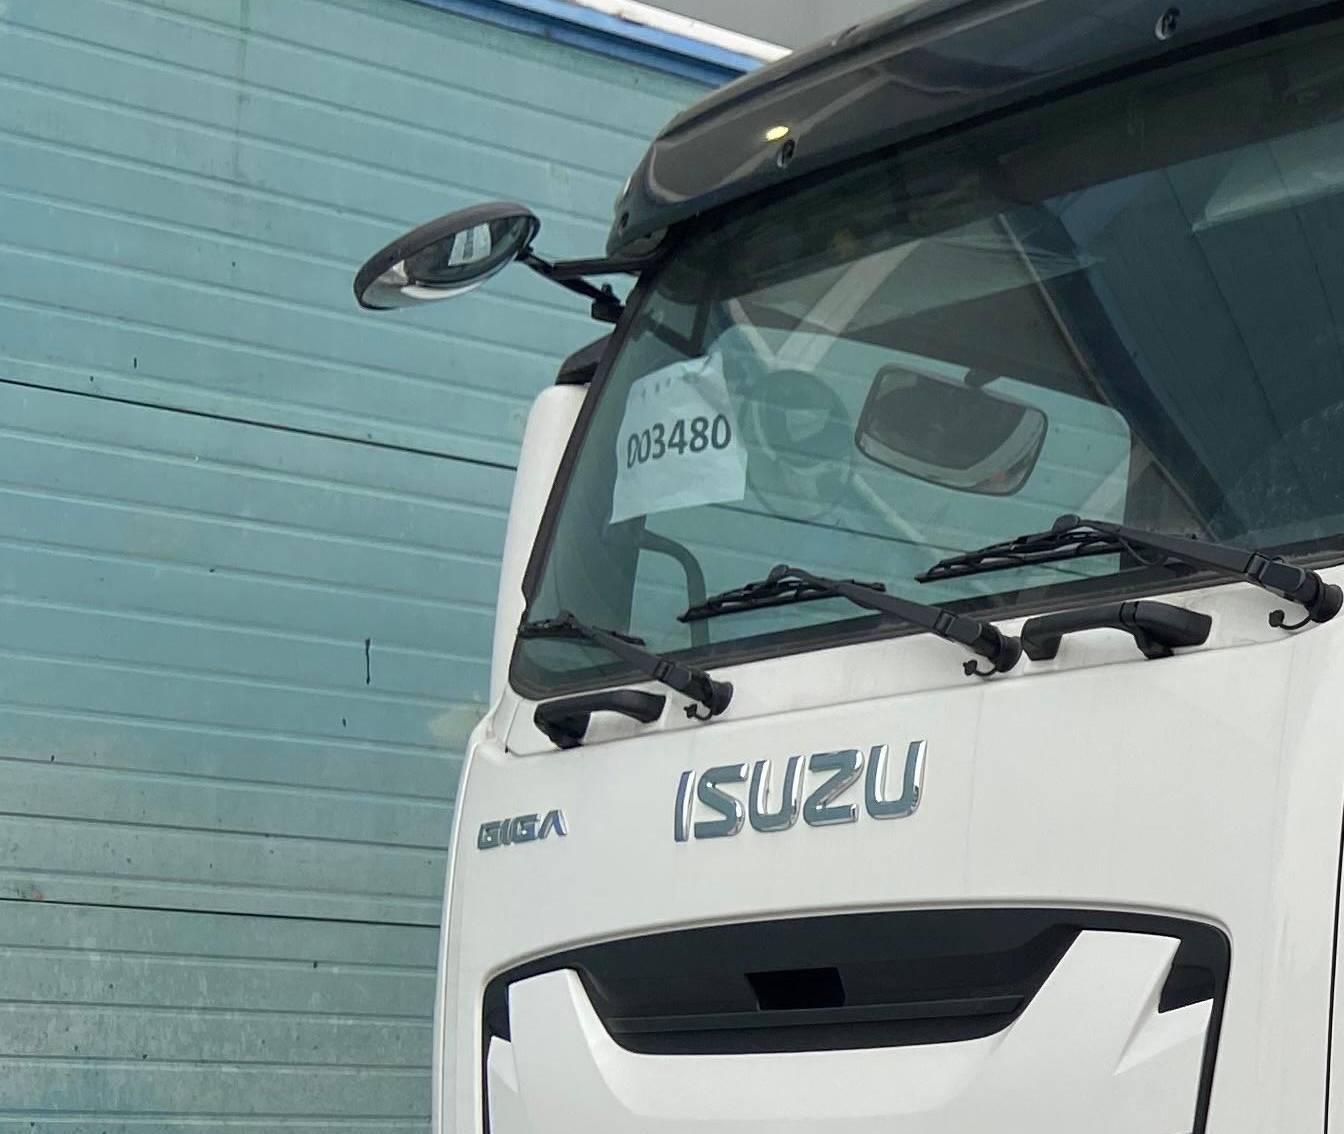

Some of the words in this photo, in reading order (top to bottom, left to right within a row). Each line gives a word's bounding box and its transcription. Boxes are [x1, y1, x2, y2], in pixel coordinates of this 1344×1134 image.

[626, 413, 732, 470] 003480
[674, 739, 927, 842] ISUZU
[477, 809, 568, 850] GIGA
